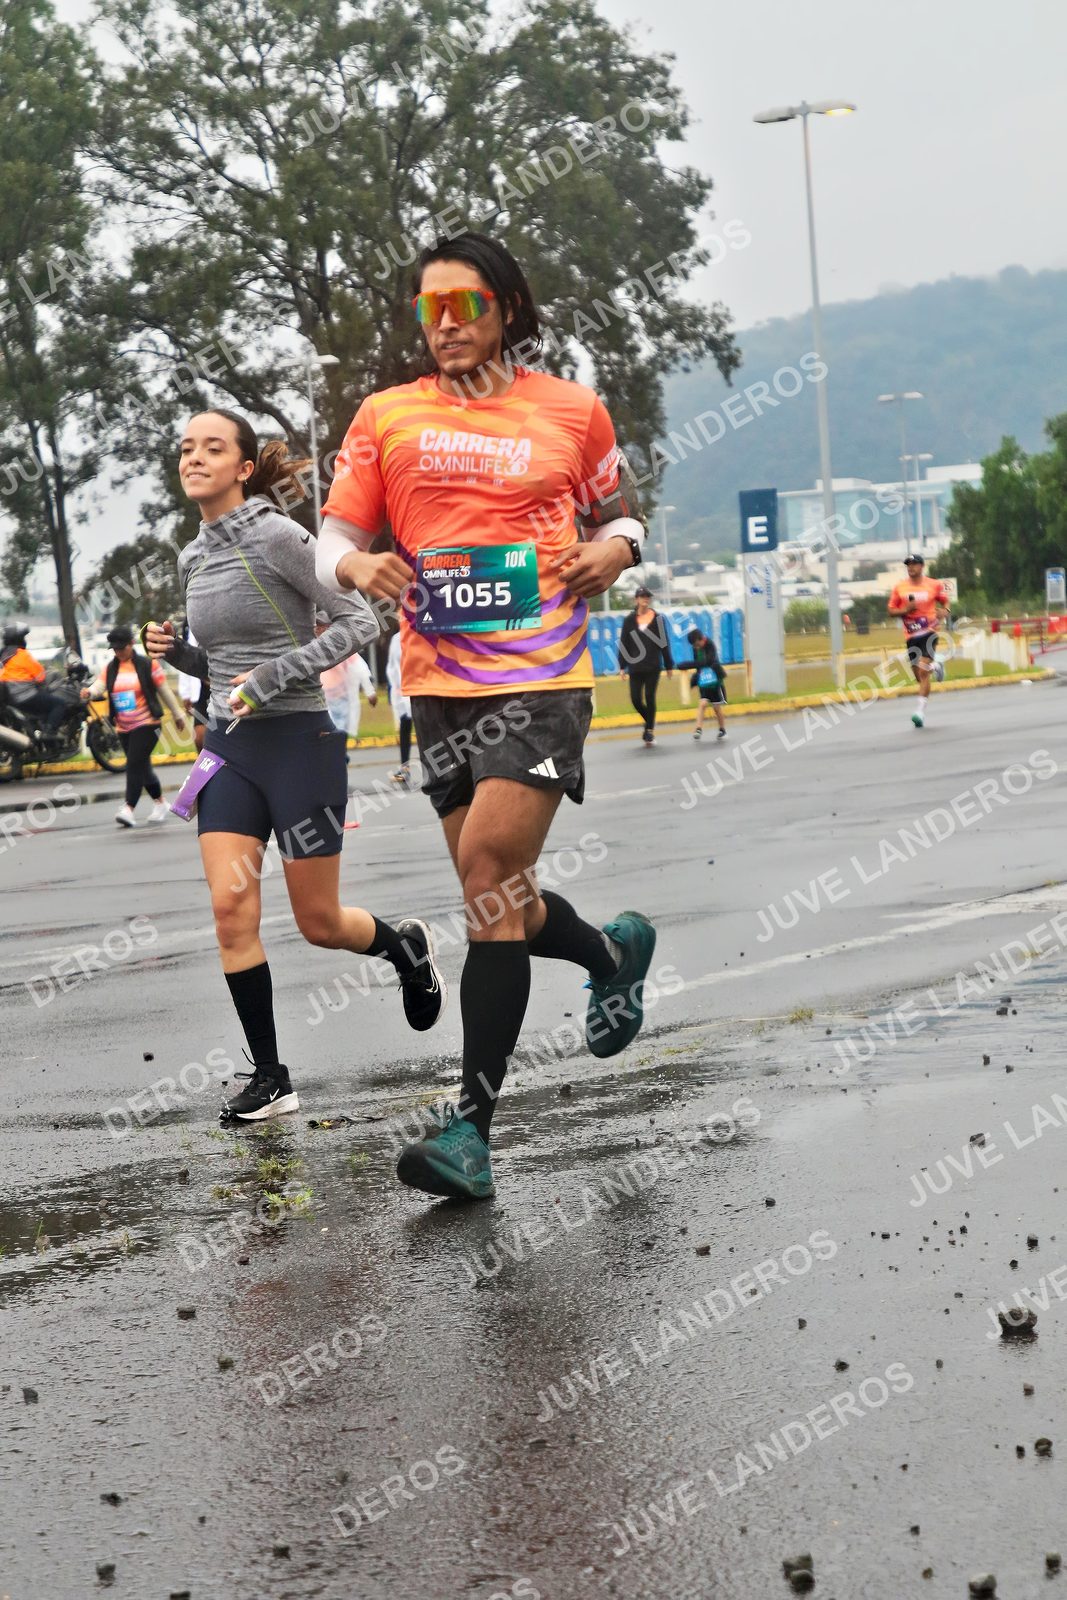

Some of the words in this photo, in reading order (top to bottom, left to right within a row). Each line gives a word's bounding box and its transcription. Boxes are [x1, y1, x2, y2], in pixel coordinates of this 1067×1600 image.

[419, 428, 531, 461] CARRERA
[747, 516, 769, 545] E
[423, 554, 471, 569] CARRERA
[504, 550, 527, 568] 10K
[439, 581, 511, 608] 1055
